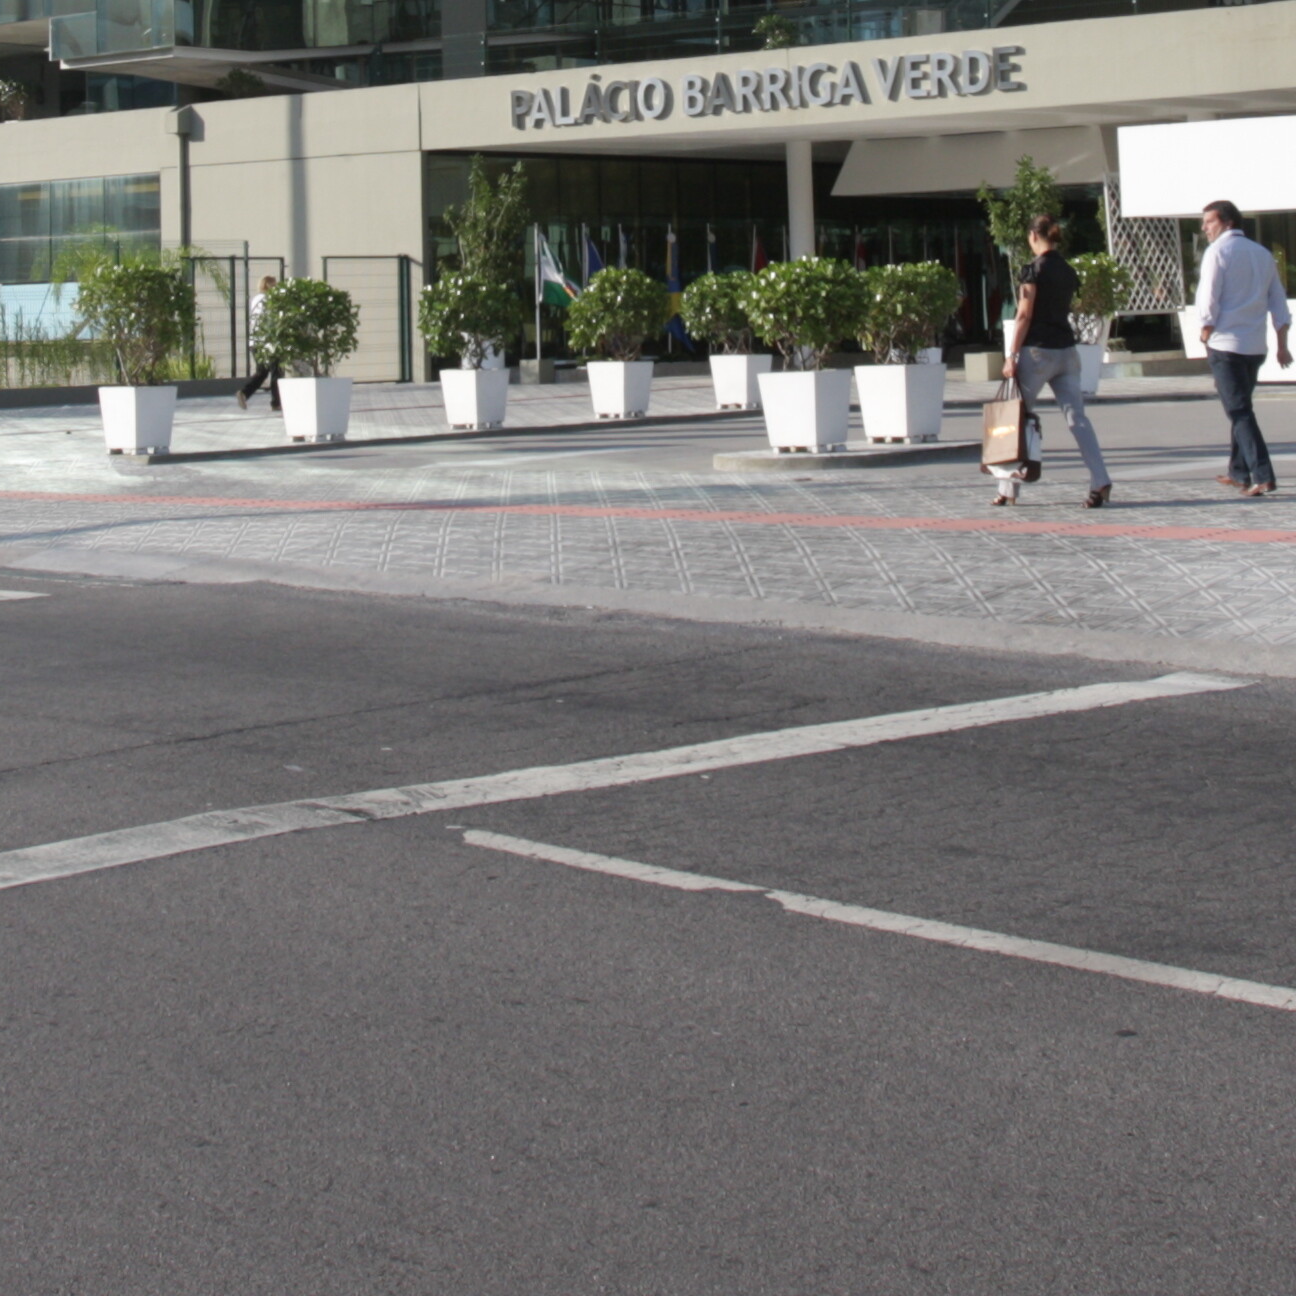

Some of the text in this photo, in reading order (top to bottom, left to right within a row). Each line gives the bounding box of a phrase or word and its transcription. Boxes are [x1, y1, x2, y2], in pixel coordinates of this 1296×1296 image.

[511, 46, 1025, 130] PALÁCIO BARRIGA VERDE
